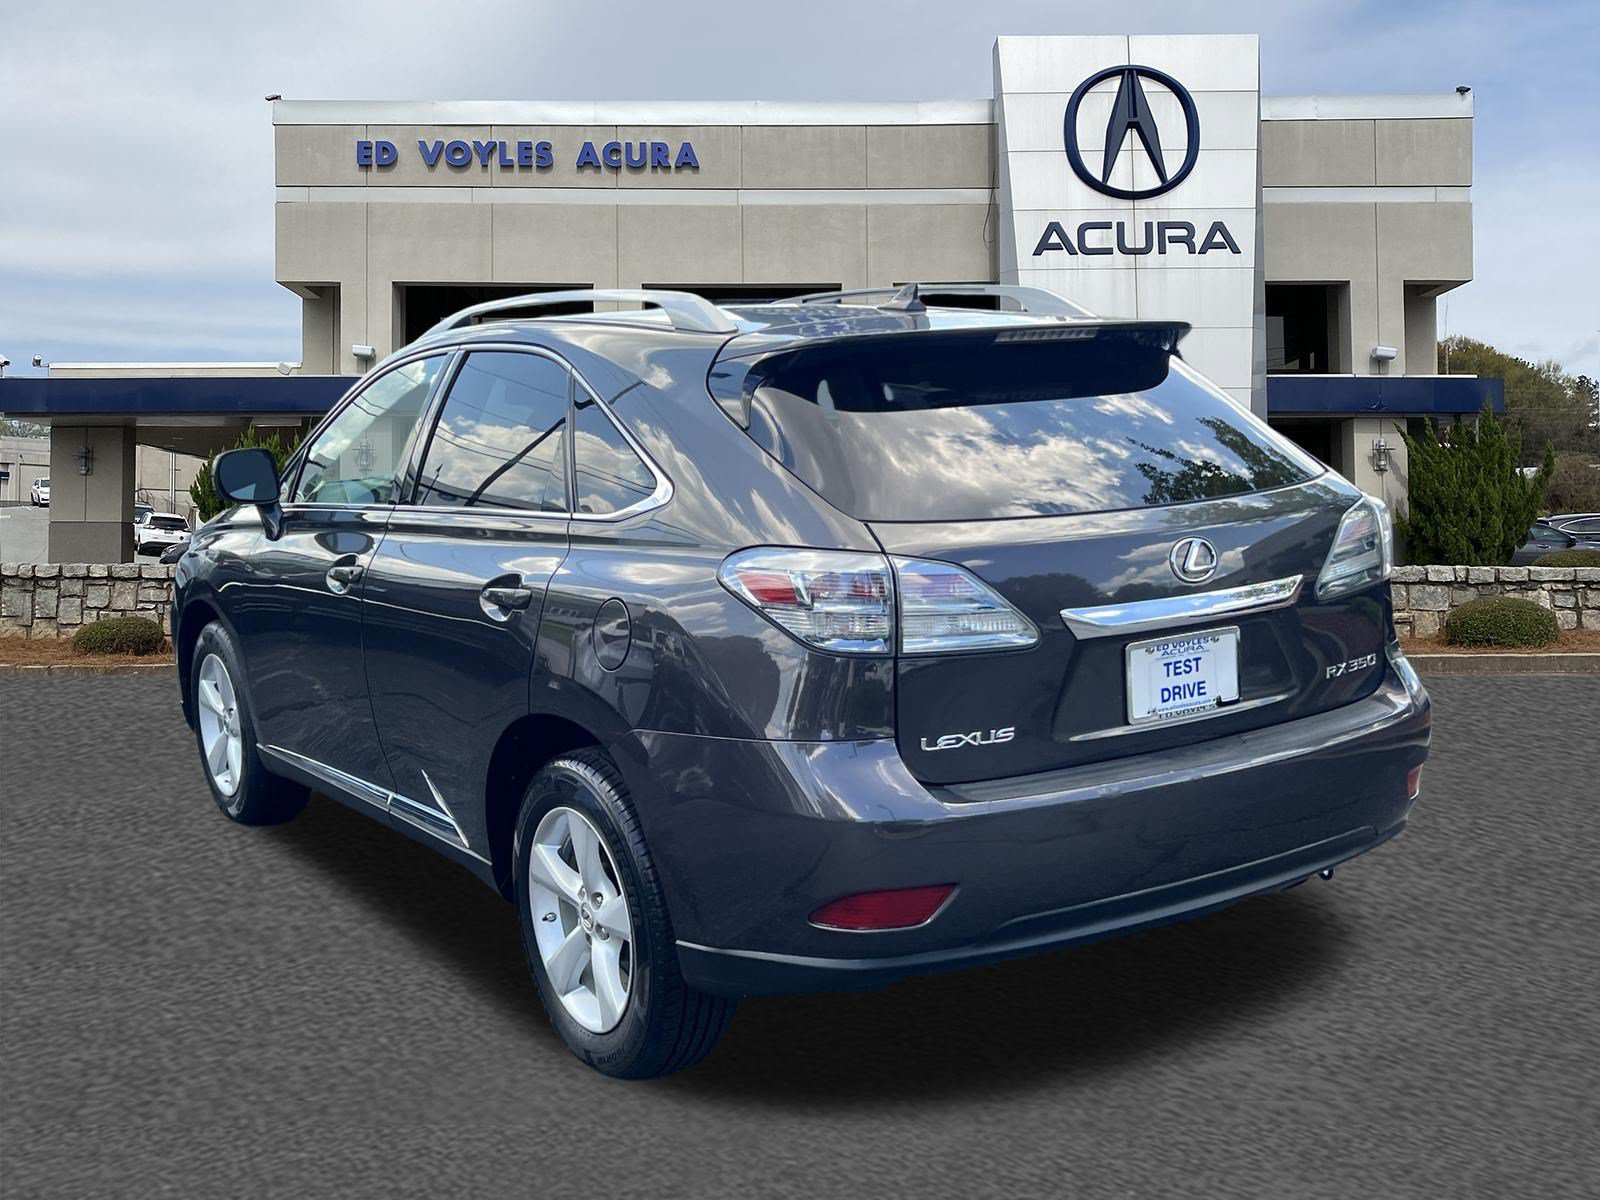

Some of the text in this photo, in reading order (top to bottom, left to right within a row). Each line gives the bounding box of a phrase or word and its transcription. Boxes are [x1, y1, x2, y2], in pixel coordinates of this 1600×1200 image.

[357, 140, 700, 168] ED VOYLES ACURA
[1032, 221, 1242, 256] ACURA
[1156, 637, 1209, 652] ED VOYLES
[1161, 645, 1205, 657] ACURA
[1163, 657, 1202, 678] TEST
[1160, 681, 1207, 704] DRIVE
[921, 727, 1015, 751] LEXUS
